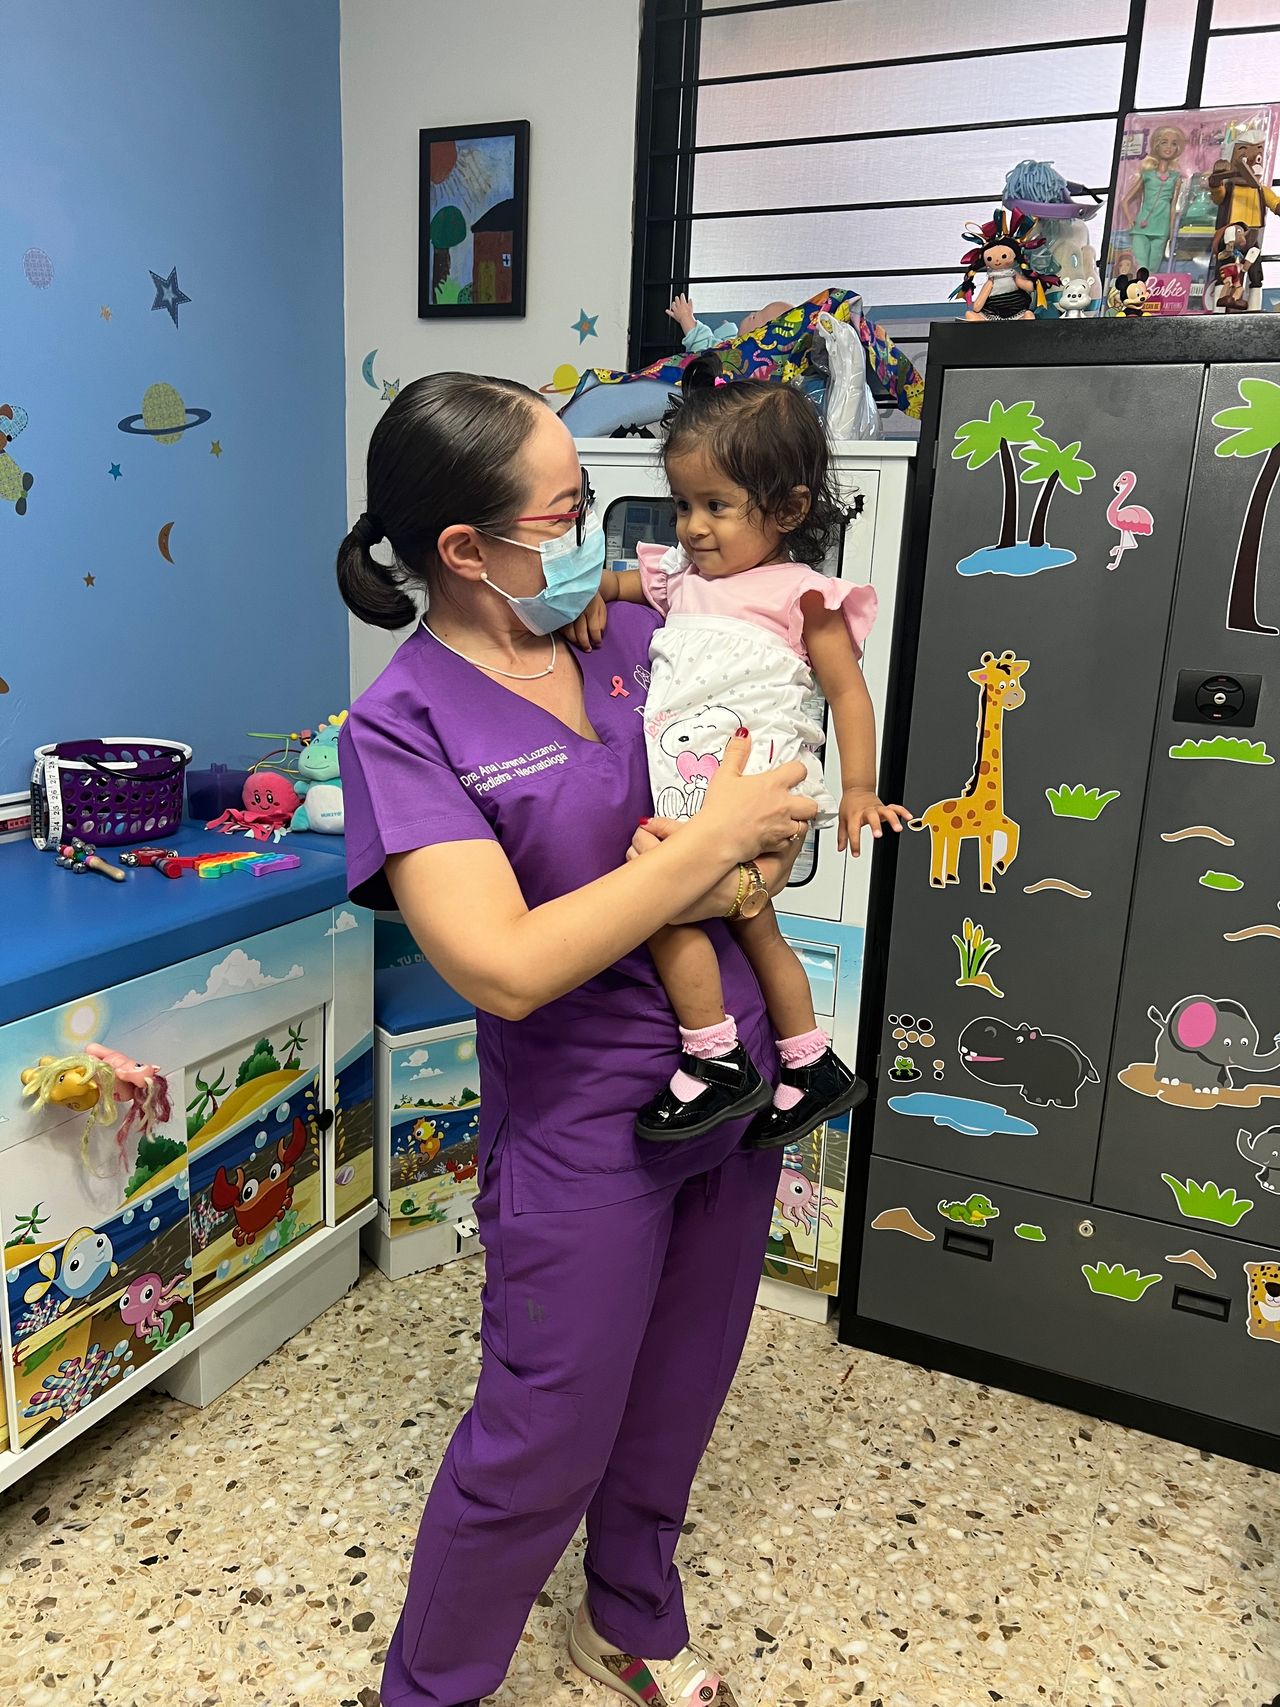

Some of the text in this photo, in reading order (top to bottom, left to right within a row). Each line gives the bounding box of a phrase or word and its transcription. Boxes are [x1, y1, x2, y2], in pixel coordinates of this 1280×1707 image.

[1146, 276, 1187, 298] Barbie
[460, 740, 567, 787] Dra. Ana Lorena Lozano L.
[49, 774, 57, 784] 27
[474, 772, 513, 796] Pediatra
[513, 752, 569, 778] Neonatologa
[51, 789, 58, 800] 26
[53, 805, 60, 816] 25
[53, 821, 60, 832] 24
